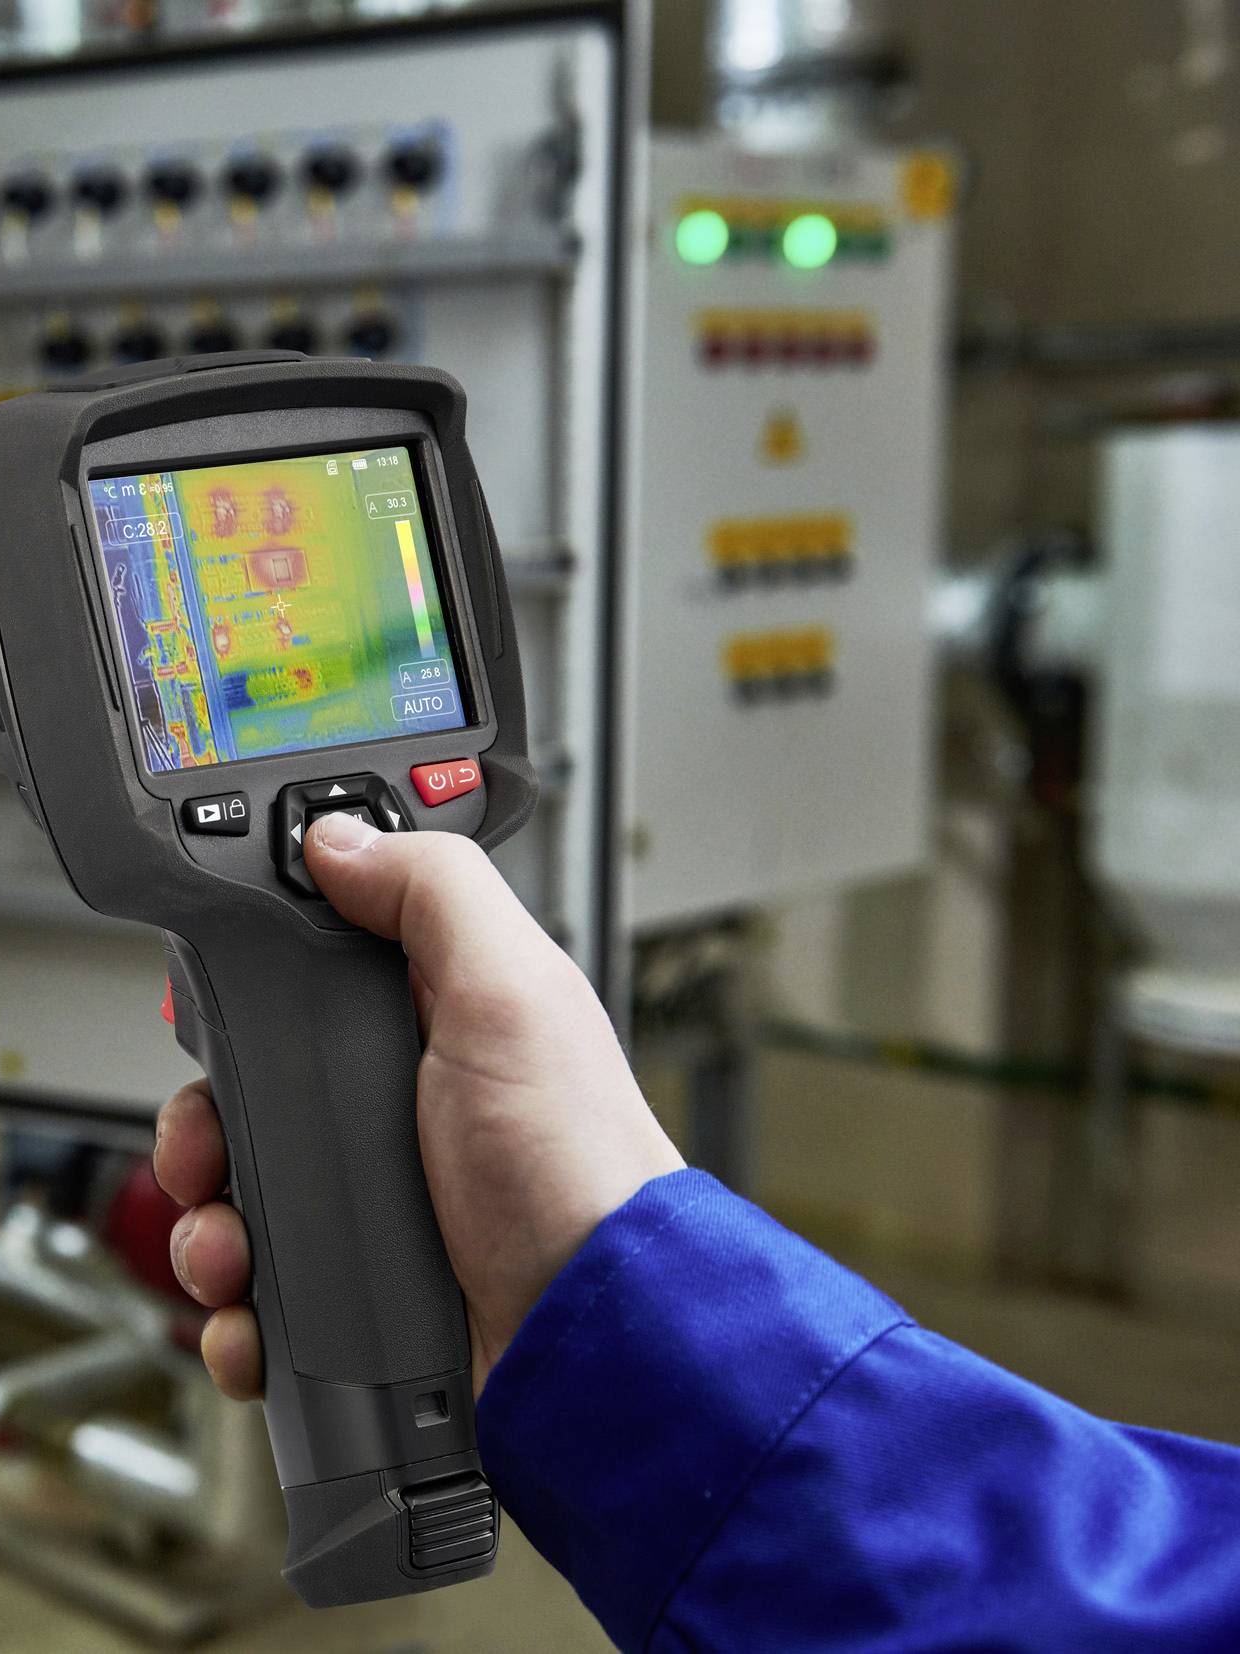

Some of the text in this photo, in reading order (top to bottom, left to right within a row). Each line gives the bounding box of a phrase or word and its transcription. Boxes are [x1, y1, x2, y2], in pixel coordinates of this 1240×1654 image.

[376, 455, 399, 467] 13:18
[121, 484, 136, 497] m
[369, 497, 407, 513] A 30.3
[123, 520, 168, 538] C:28.2
[403, 667, 441, 683] A 25.8
[404, 696, 443, 715] AUTO
